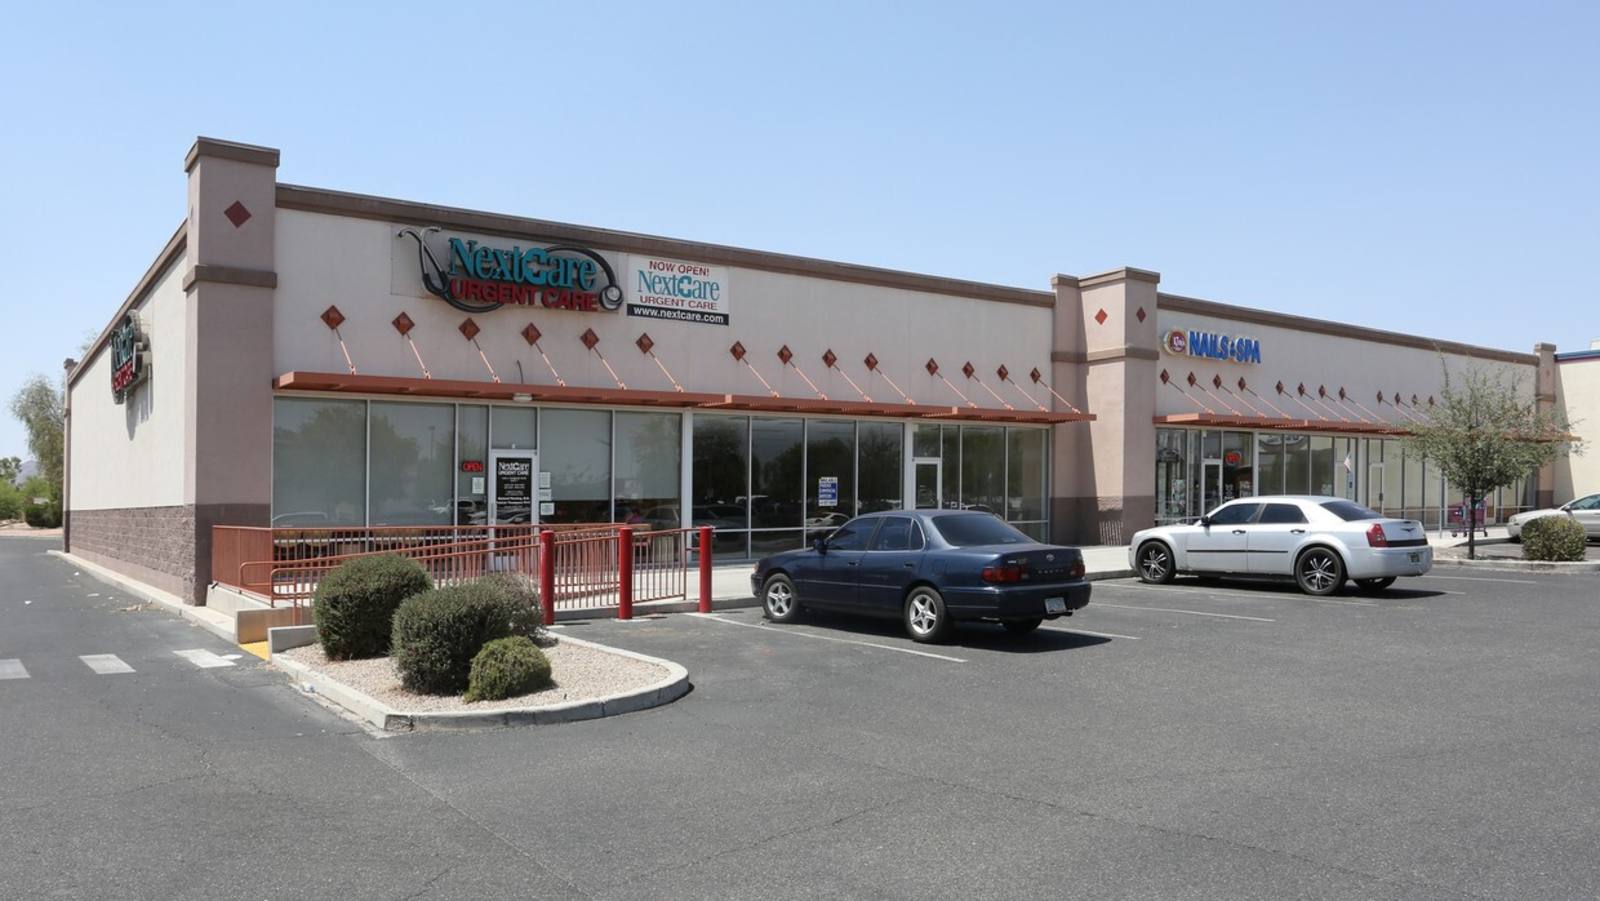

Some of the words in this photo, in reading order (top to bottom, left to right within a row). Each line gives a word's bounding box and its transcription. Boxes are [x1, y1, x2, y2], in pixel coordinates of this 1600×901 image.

[448, 238, 597, 291] NextCare
[649, 260, 675, 273] NOW
[678, 264, 710, 277] OPEN!
[449, 278, 538, 306] URGENT
[542, 287, 600, 312] CARE
[637, 270, 720, 301] NextCare
[633, 306, 724, 324] www.nextcare.com
[640, 295, 685, 308] URGENT
[688, 300, 719, 311] CARE
[1188, 330, 1229, 360] NAILS
[1236, 336, 1262, 364] SPA
